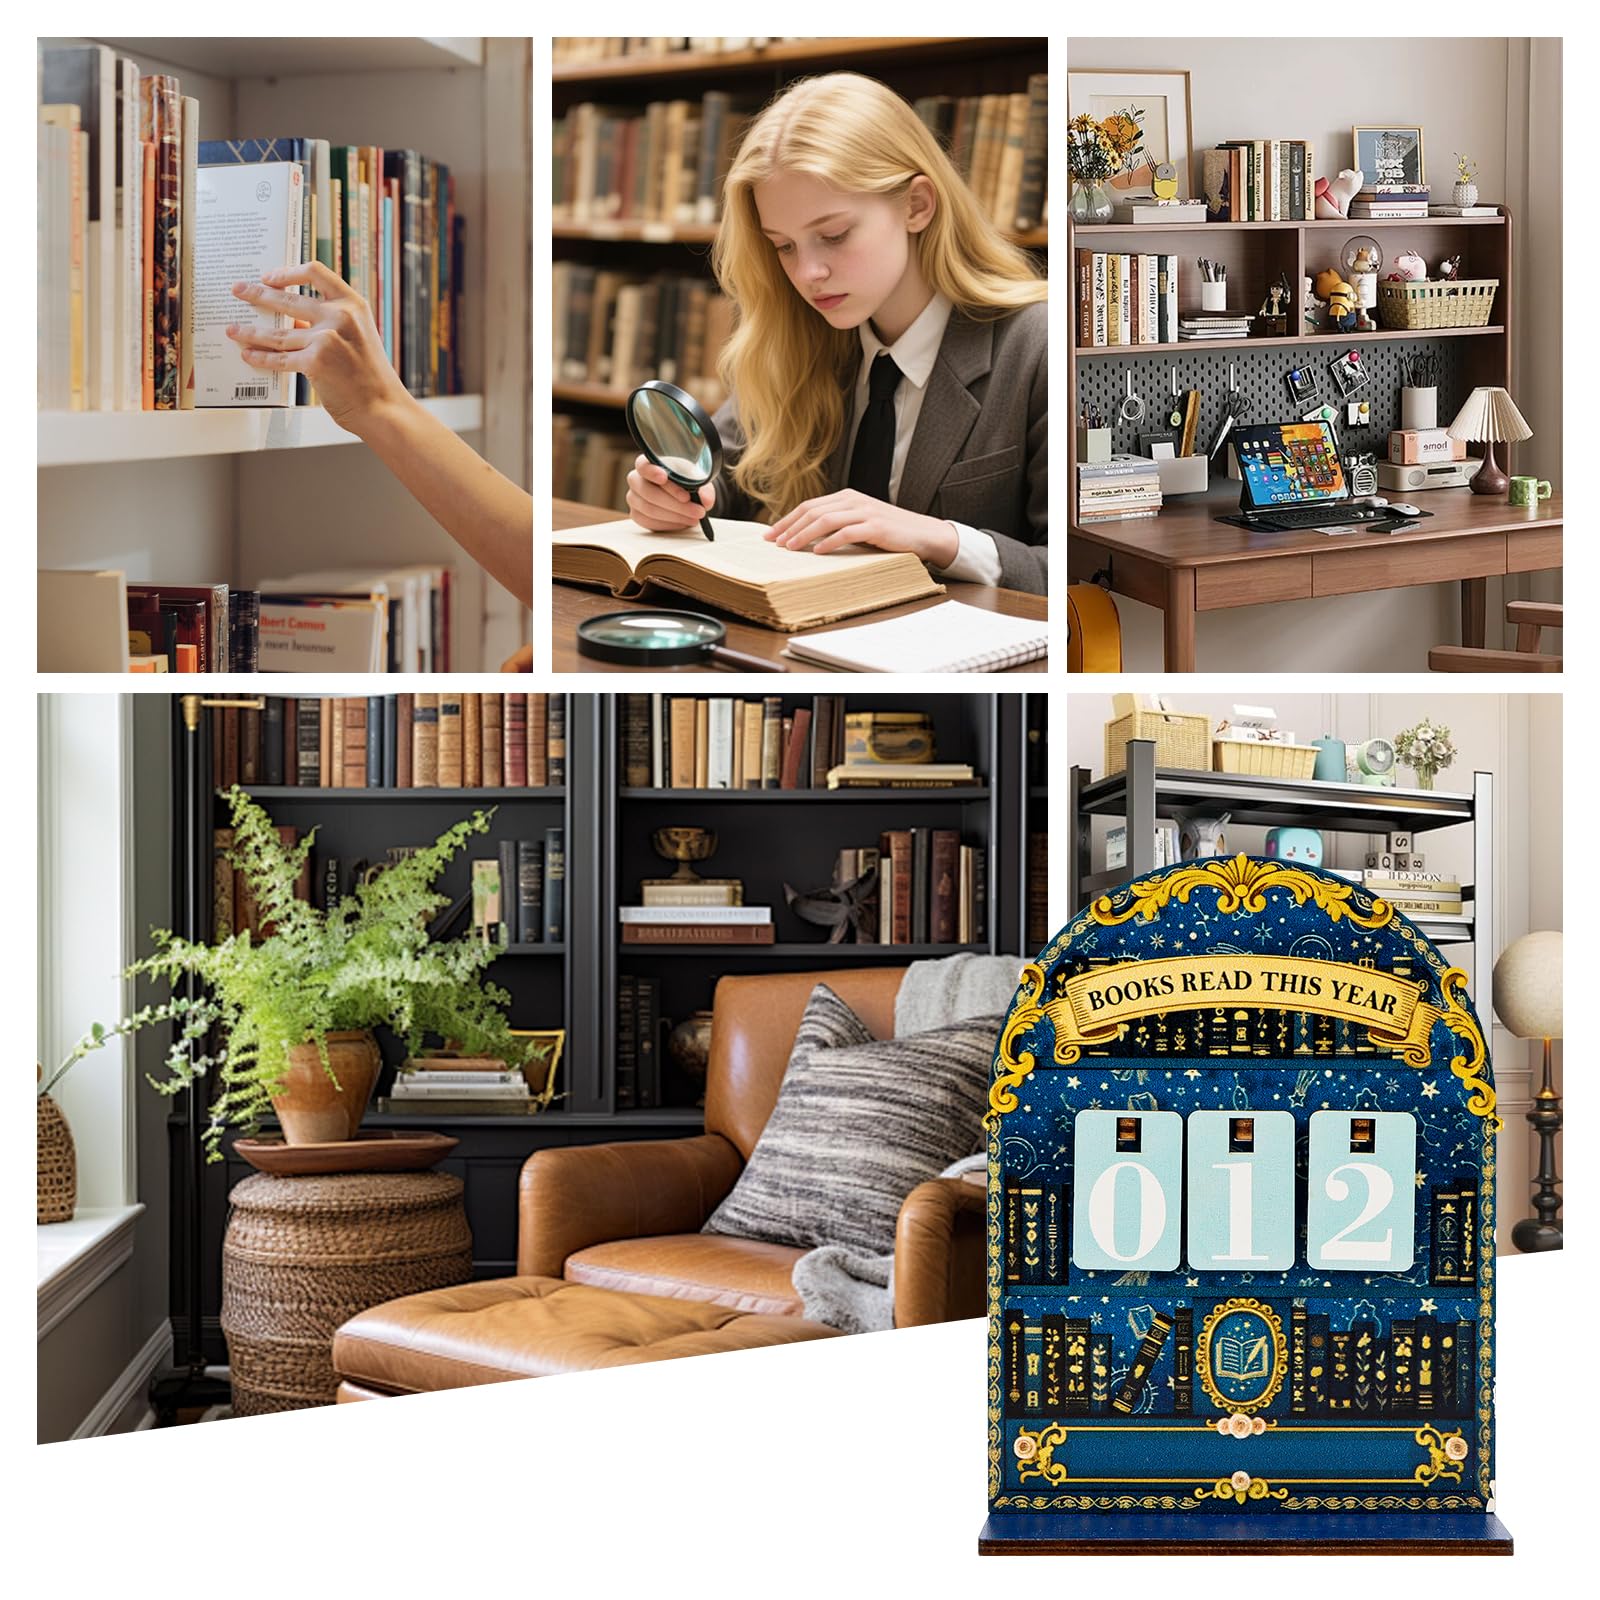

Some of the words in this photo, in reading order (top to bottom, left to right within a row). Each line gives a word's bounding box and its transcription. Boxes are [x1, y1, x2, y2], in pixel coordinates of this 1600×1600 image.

[261, 614, 285, 627] lbert
[288, 616, 326, 631] Camus
[1087, 971, 1175, 1012] BOOKS
[1181, 970, 1253, 993] READ
[1261, 970, 1321, 997] THIS
[1332, 979, 1399, 1016] YEAR
